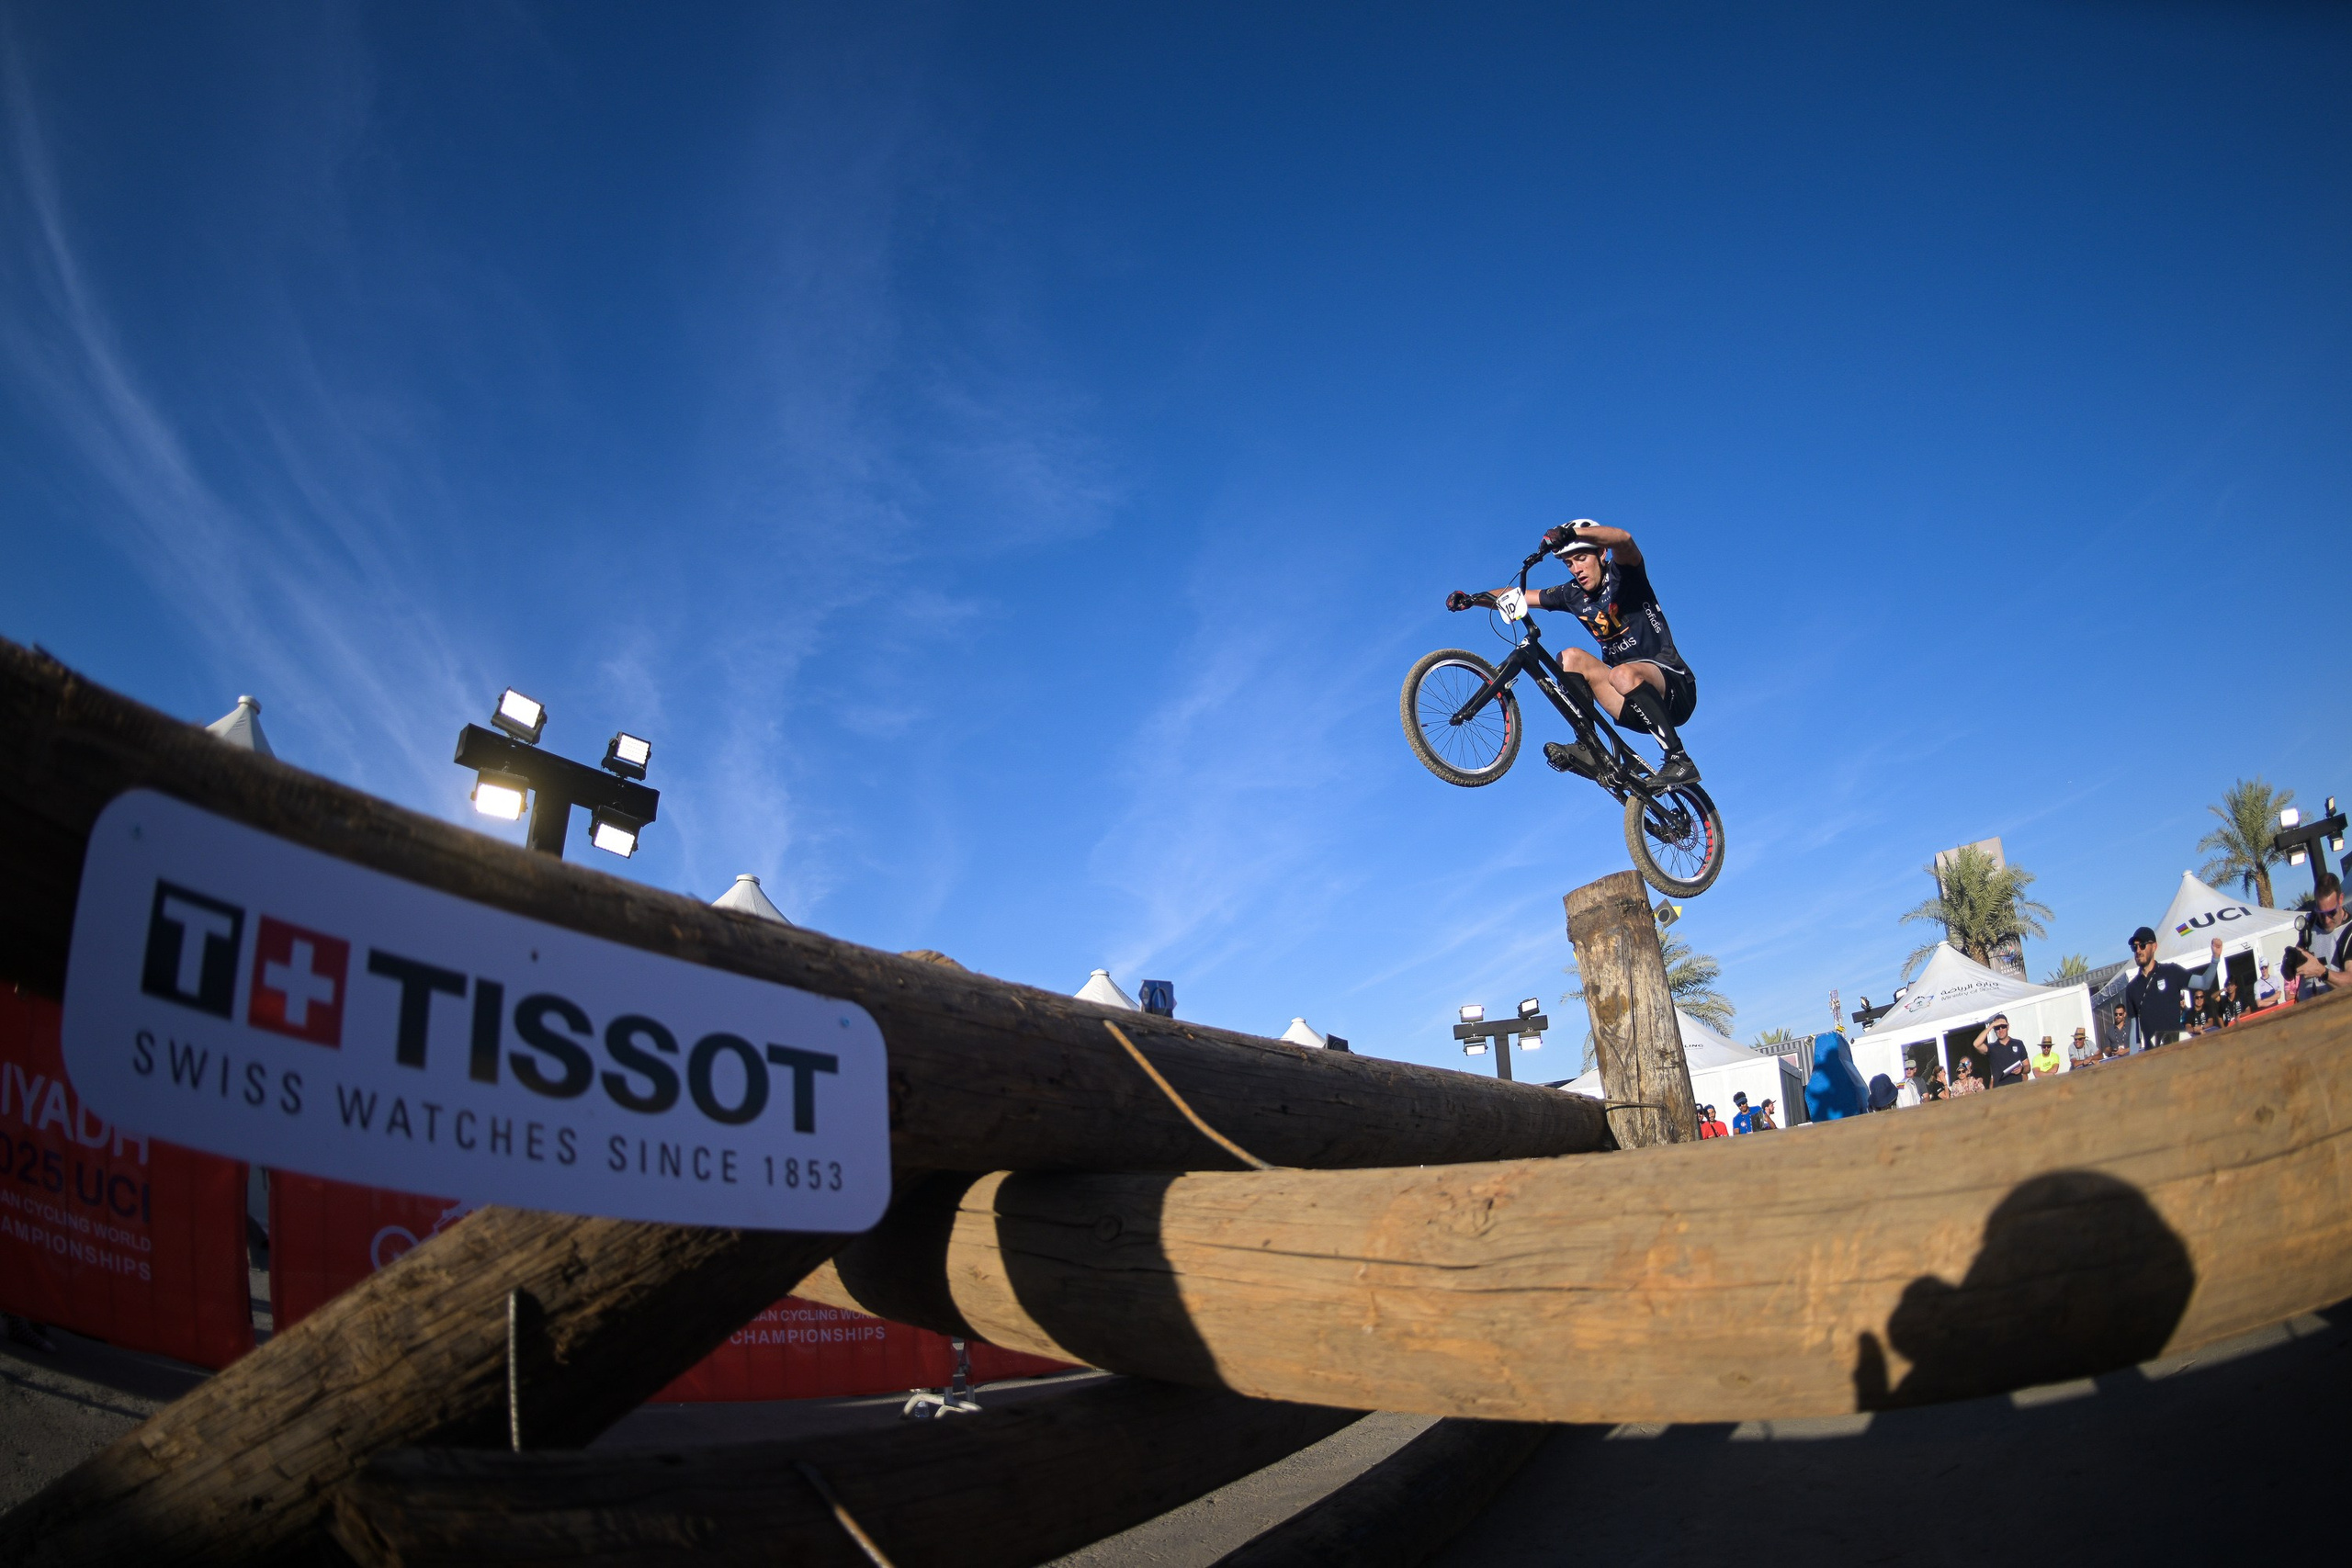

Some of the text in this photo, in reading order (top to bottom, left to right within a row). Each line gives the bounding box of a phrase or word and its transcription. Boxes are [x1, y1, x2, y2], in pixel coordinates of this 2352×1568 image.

[1643, 602, 1662, 634] Cofidis
[2188, 906, 2252, 929] UCI
[368, 948, 839, 1134] TISSOT
[133, 1030, 842, 1191] SWISS WATCHES SINCE 1853
[76, 1161, 150, 1224] UCI
[24, 1197, 90, 1233] CYCLING
[94, 1223, 152, 1253] WORLD
[729, 1326, 886, 1345] CHAMPIONSHIPS
[780, 1309, 838, 1322] CYCLING
